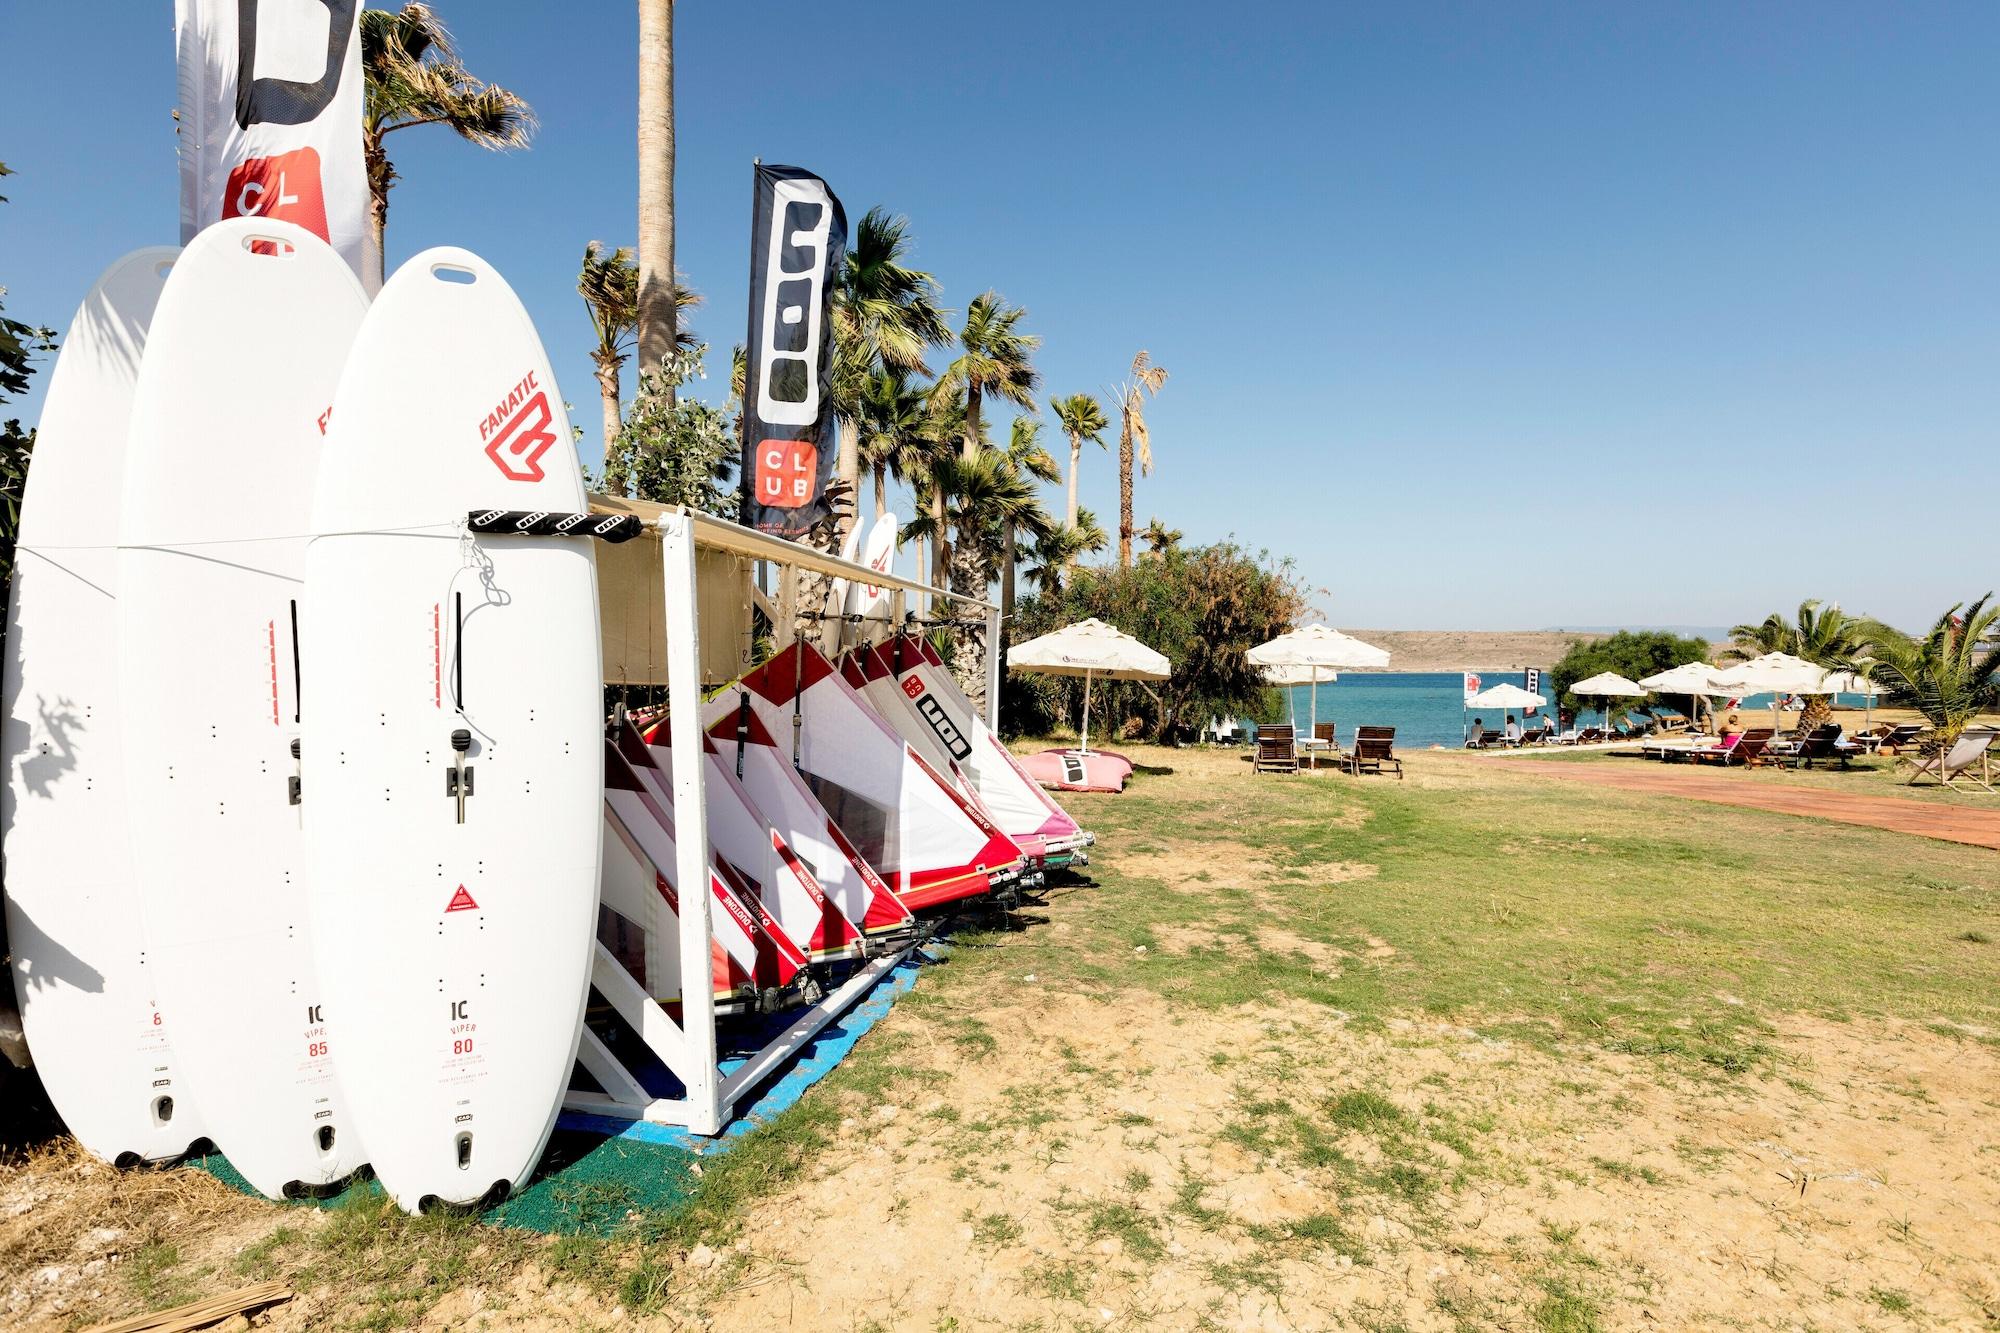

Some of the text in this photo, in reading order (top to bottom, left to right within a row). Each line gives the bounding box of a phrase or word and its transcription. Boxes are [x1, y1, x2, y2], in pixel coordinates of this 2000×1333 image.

[479, 370, 538, 441] FANATIC
[851, 856, 873, 881] DUOTONE
[796, 870, 818, 896] DUOTONE
[723, 895, 752, 926] DUOTONE
[741, 892, 765, 920] DUOTONE
[451, 1000, 468, 1021] IC
[450, 1023, 477, 1034] VIPER
[309, 1041, 328, 1057] 85
[454, 1039, 473, 1054] 80
